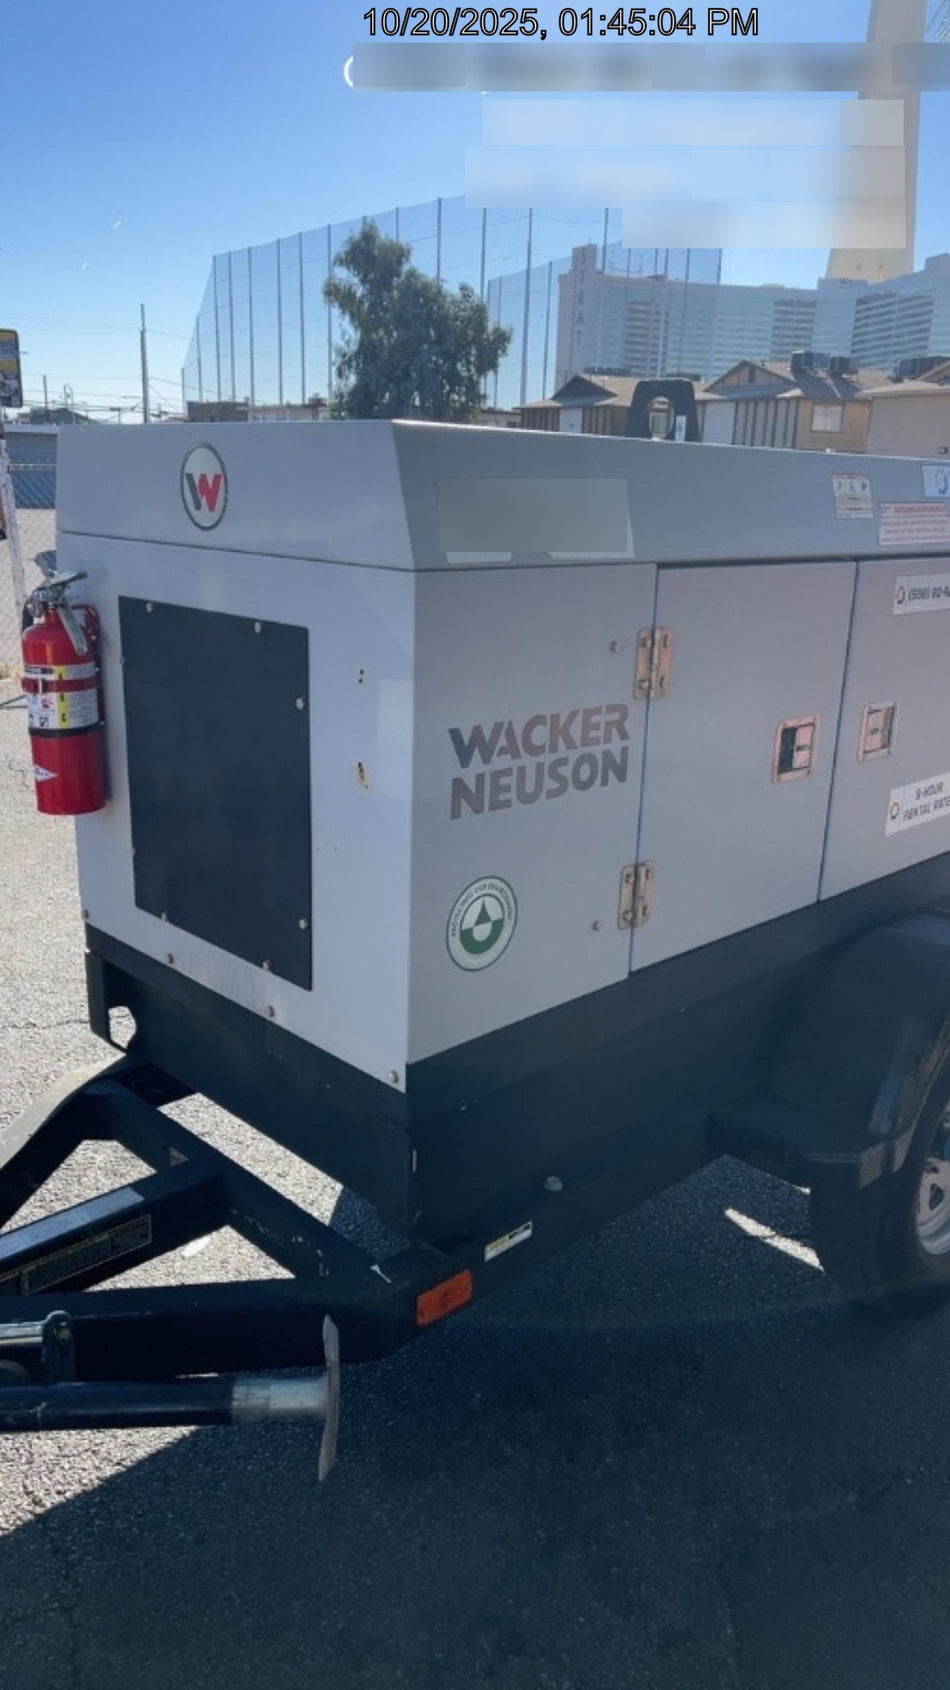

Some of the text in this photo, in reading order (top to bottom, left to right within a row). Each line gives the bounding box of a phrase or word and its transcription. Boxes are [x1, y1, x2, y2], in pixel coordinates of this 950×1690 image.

[185, 472, 223, 512] W
[448, 703, 630, 769] WACKER
[450, 745, 630, 820] NEUSON
[903, 803, 931, 821] RENTAL
